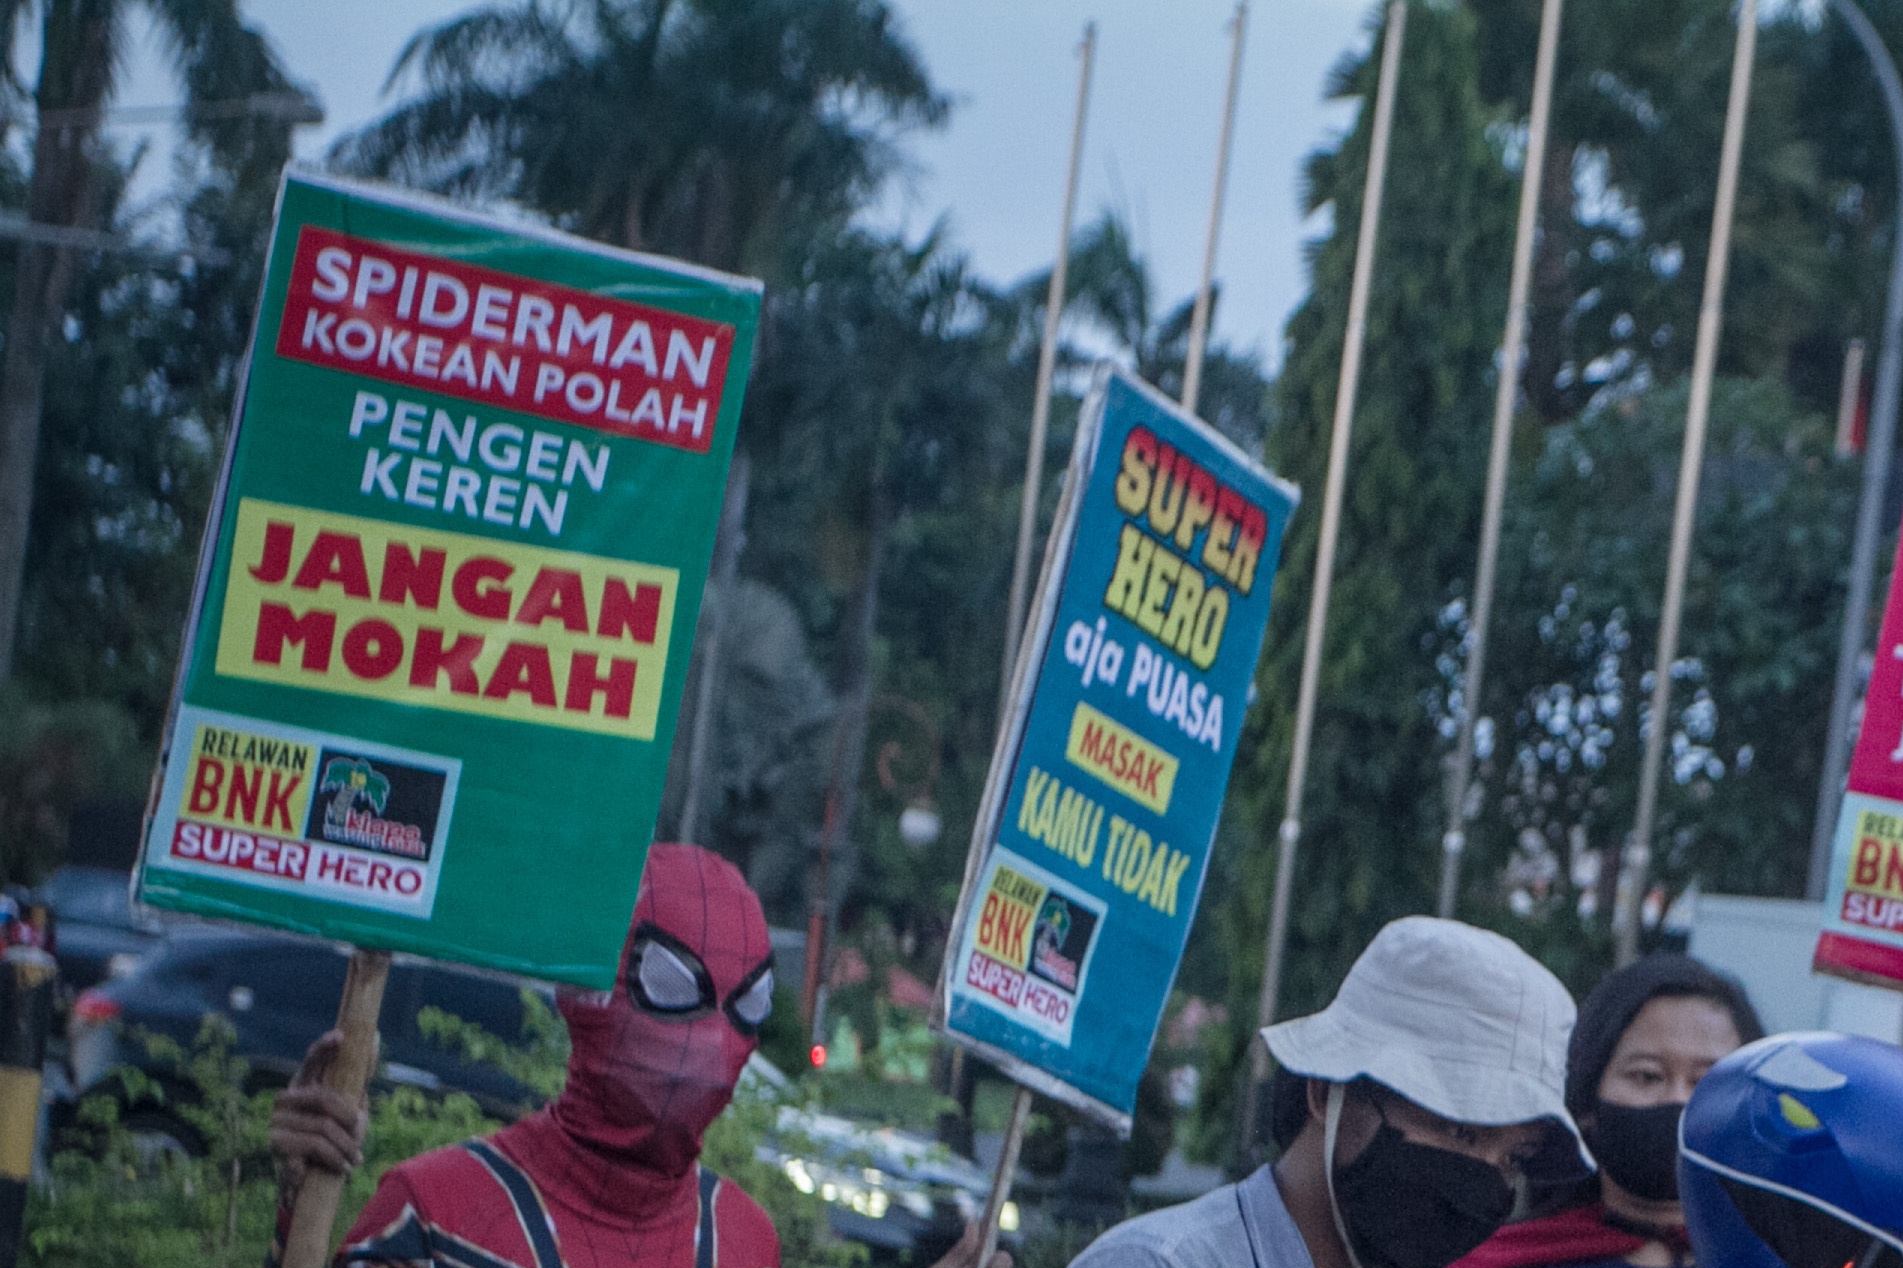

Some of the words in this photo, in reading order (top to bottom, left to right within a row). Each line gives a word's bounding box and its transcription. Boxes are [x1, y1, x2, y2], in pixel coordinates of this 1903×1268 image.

[312, 247, 717, 388] SPIDERMAN
[302, 308, 521, 396] KOKEAN
[533, 362, 708, 438] POLAH
[349, 391, 610, 492] PENGEN
[360, 448, 569, 535] KEREN
[1115, 424, 1268, 595] SUPER
[247, 521, 663, 645] JANGAN
[1105, 522, 1230, 671] HERO
[252, 602, 637, 719] MOKAH
[1065, 617, 1117, 688] aja
[1126, 643, 1223, 751] PUASA
[188, 757, 303, 833] BNK
[201, 727, 307, 771] RELAWAN
[1078, 718, 1166, 798] MASAK
[178, 823, 306, 879] SUPER
[318, 851, 421, 895] HERO
[1018, 766, 1102, 870] KAMU
[1102, 815, 1191, 917] TIDAK
[979, 892, 1032, 966] BNK
[968, 953, 1024, 1007] SUPER
[1024, 980, 1069, 1024] HERO
